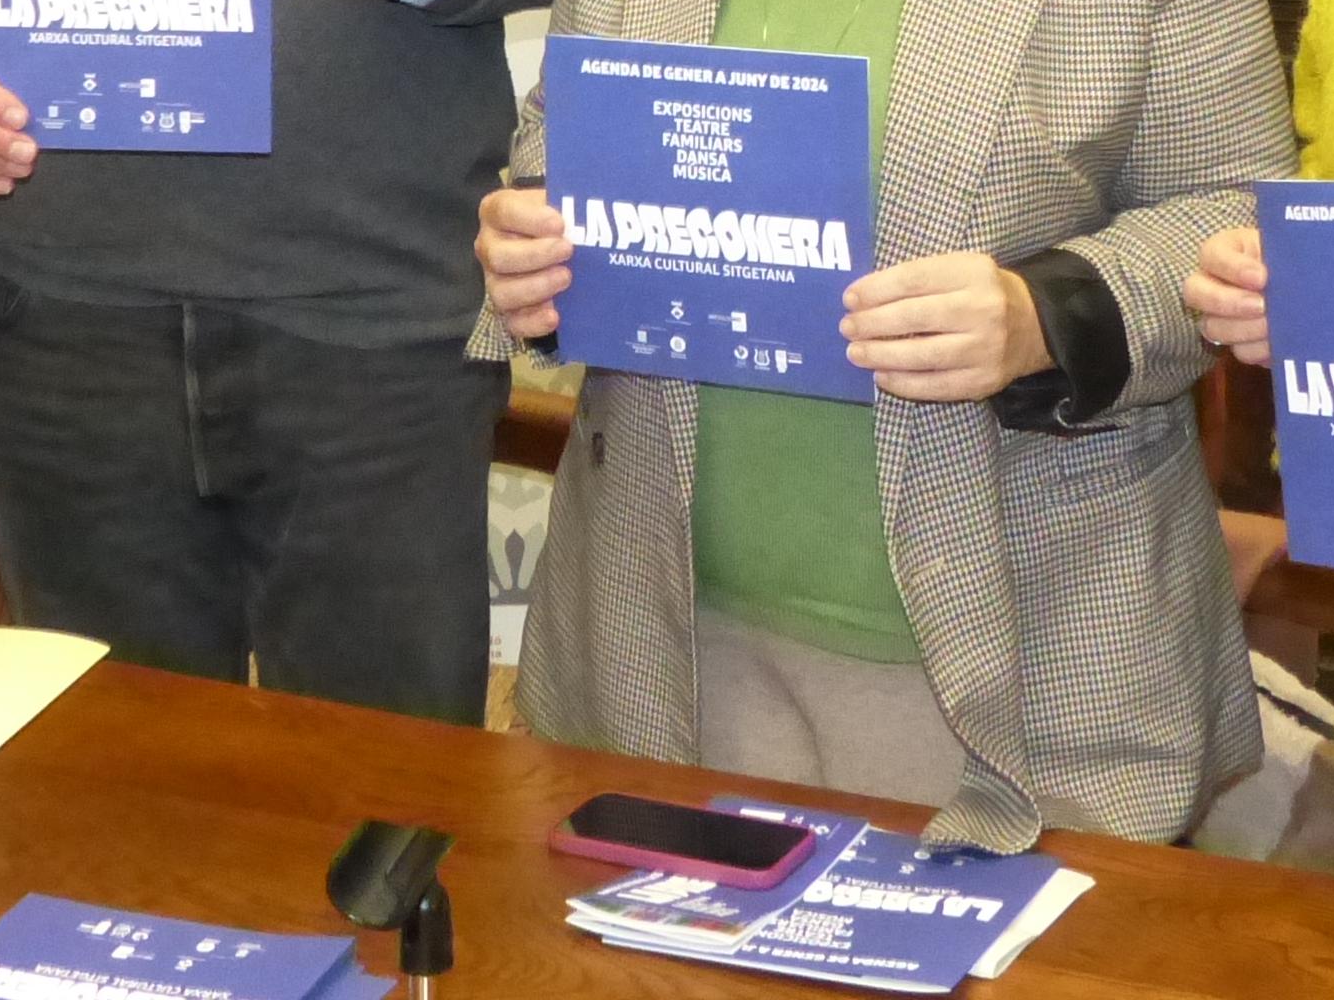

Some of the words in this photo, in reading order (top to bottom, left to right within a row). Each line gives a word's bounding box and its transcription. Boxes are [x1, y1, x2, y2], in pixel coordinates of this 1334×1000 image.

[28, 32, 70, 44] XARXA
[71, 33, 133, 46] CULTURAL
[135, 34, 202, 47] SITGETANA
[581, 59, 640, 78] AGENDA
[642, 65, 661, 80] DE
[663, 66, 713, 84] GENER
[714, 70, 727, 84] A
[727, 72, 767, 88] JUNY
[769, 75, 789, 90] DE
[791, 77, 828, 92] 2024
[653, 100, 752, 123] EXPOSICIONS
[674, 118, 730, 136] TEATRE
[662, 132, 743, 153] FAMILIARS
[676, 150, 727, 167] DANSA
[673, 161, 732, 183] MÚSICA
[562, 196, 615, 249] LA
[609, 253, 651, 269] XARXA
[654, 257, 720, 276] CULTURAL
[722, 264, 795, 284] SITGETANA
[1284, 359, 1333, 417] LA
